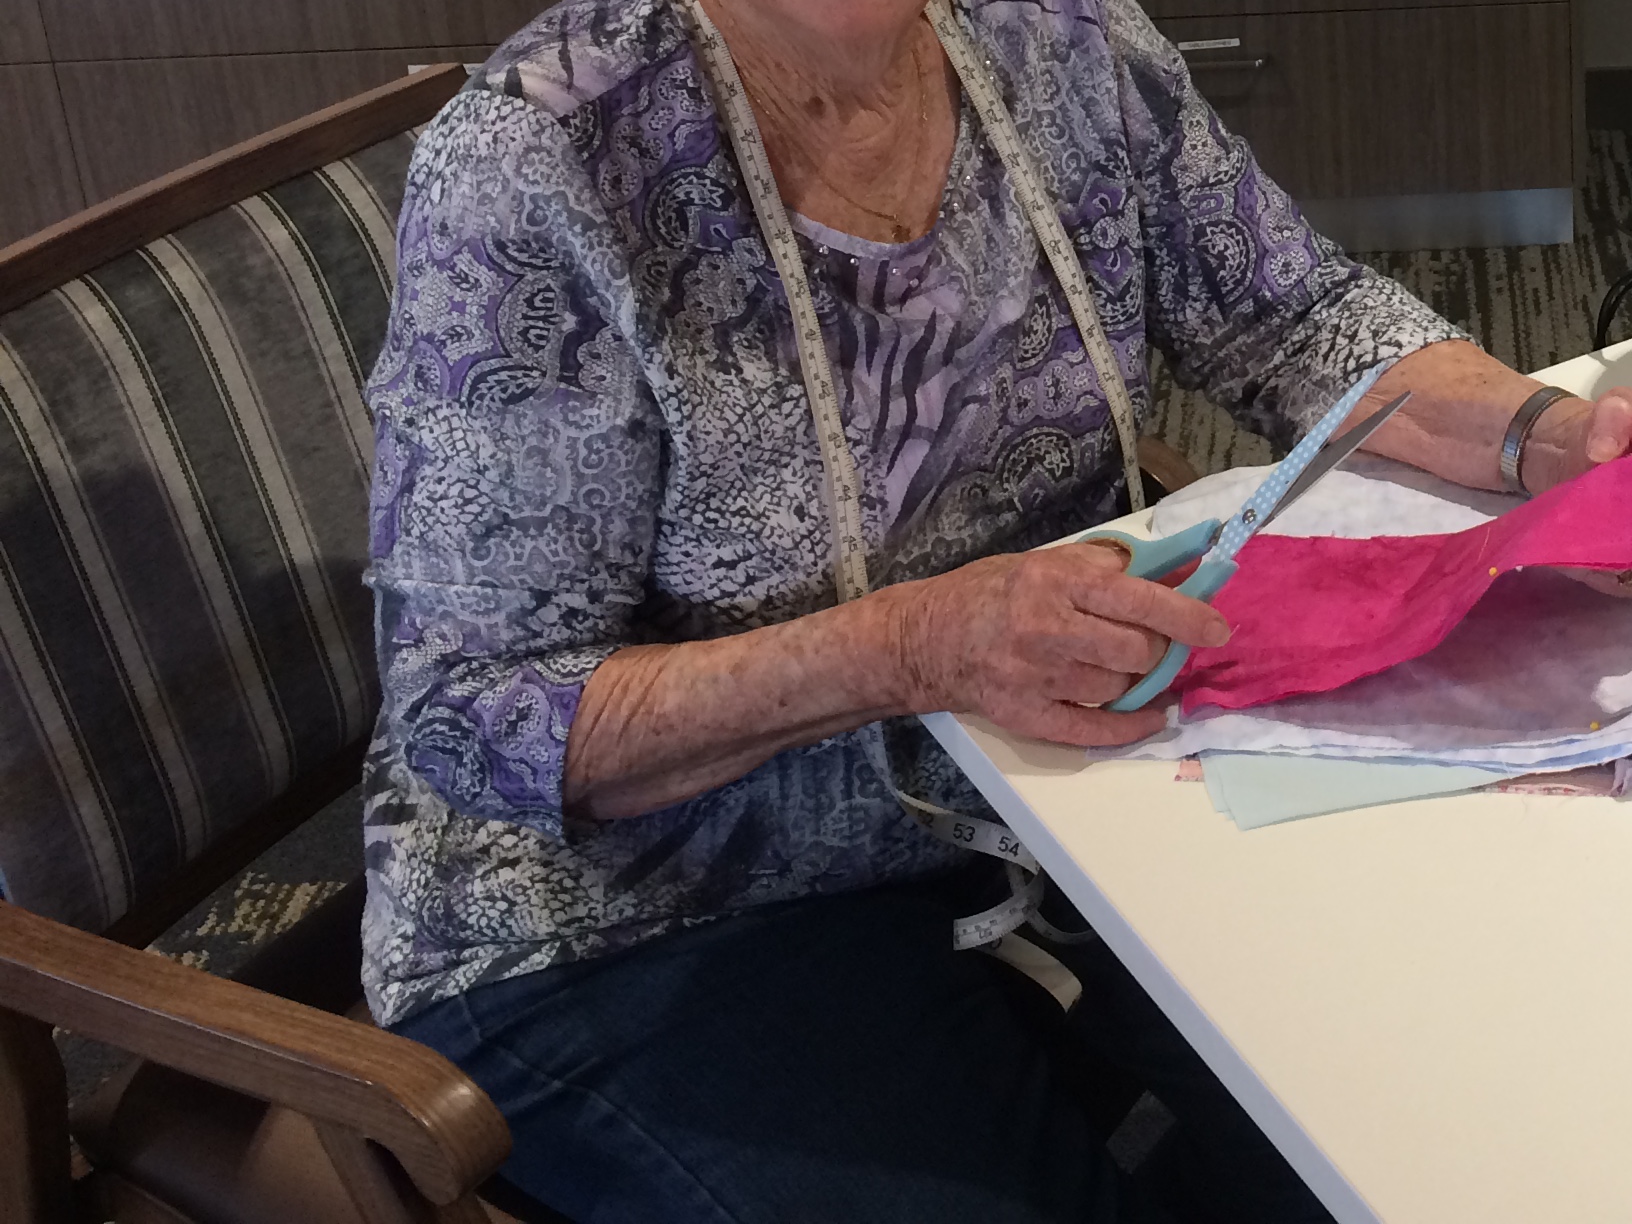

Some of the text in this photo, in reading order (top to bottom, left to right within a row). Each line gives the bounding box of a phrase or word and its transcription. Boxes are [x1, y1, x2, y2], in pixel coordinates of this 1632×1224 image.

[705, 33, 720, 50] 35
[725, 81, 738, 98] 36
[741, 128, 757, 144] 37
[778, 227, 790, 244] 39
[821, 380, 832, 397] 42
[842, 484, 852, 501] 44
[848, 536, 858, 552] 45
[953, 823, 976, 843] 53
[998, 836, 1020, 857] 54
